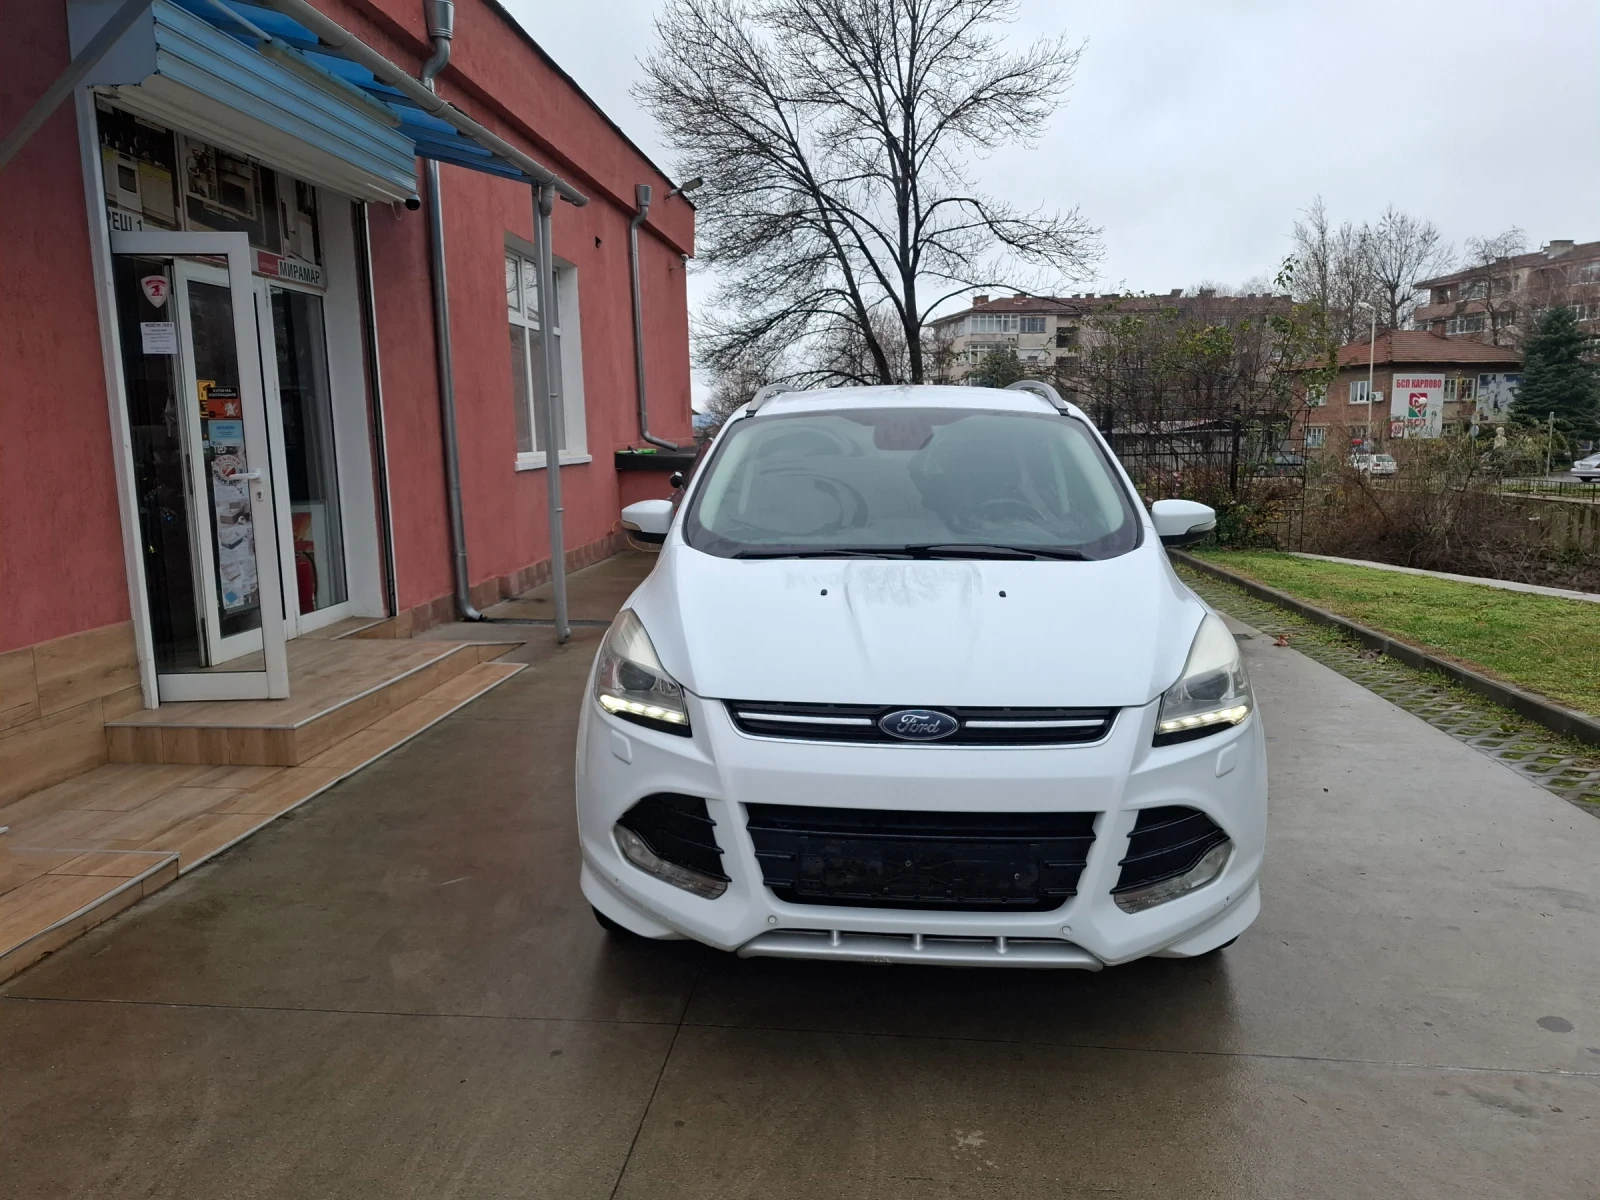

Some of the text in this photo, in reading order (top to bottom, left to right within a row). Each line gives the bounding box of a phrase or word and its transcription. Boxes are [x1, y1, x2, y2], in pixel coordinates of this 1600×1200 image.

[279, 260, 320, 284] МИРАМАР
[1396, 379, 1442, 388] БСП КАРЛОВО
[896, 714, 941, 733] Ford
